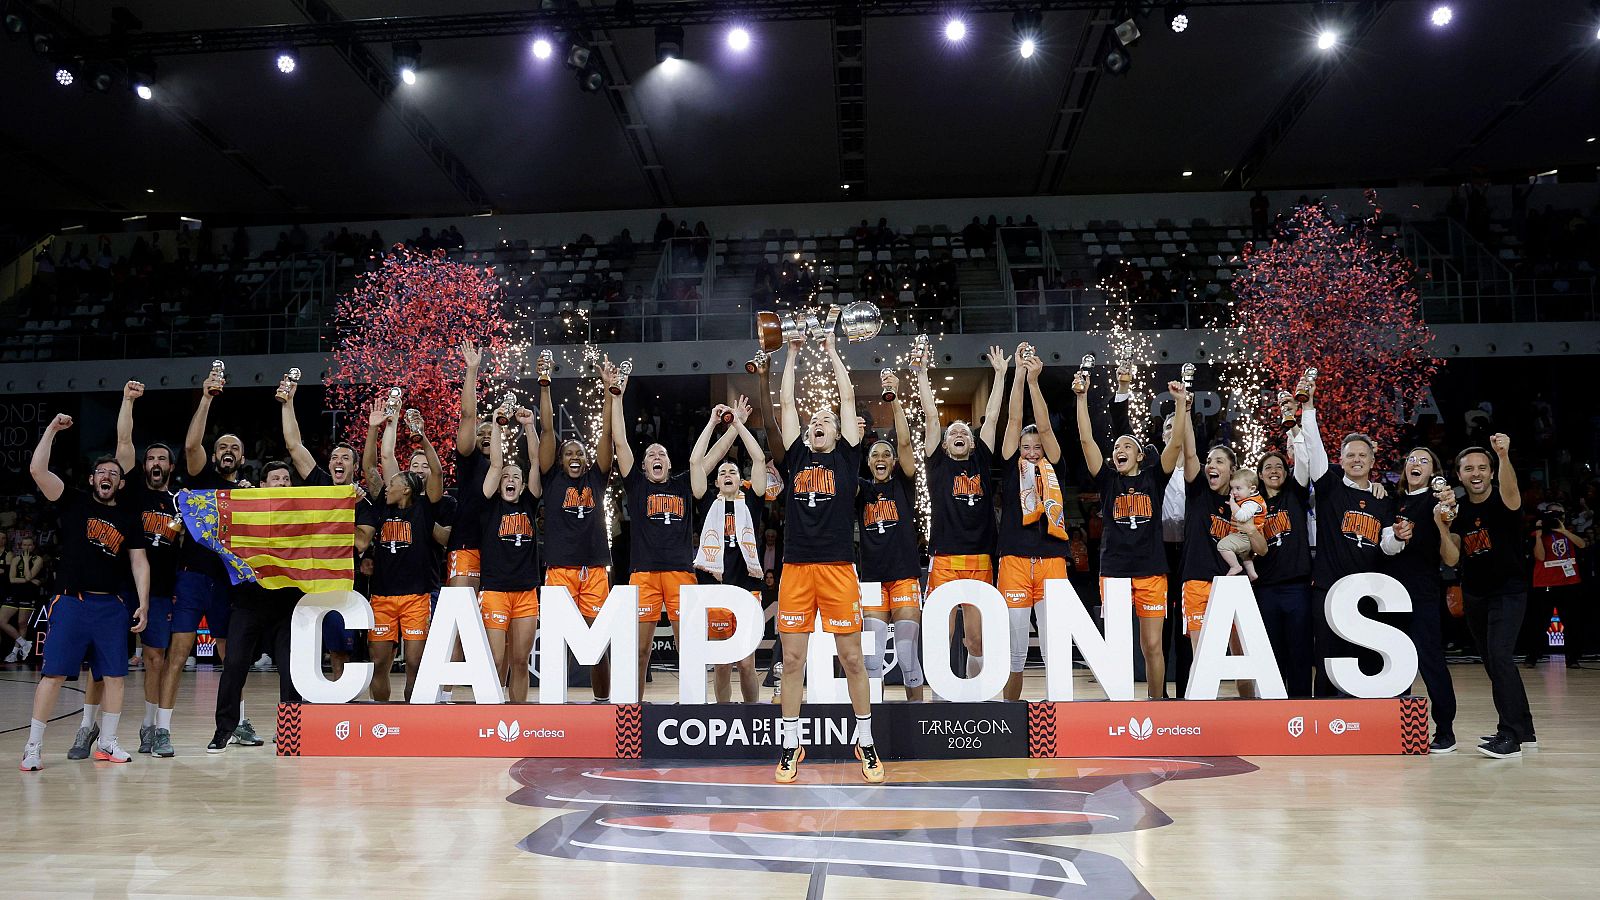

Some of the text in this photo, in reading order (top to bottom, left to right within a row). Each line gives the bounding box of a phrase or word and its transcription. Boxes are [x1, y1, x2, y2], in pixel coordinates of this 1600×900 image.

[752, 718, 771, 731] DE
[918, 719, 1012, 735] TARRAGONA
[1108, 725, 1201, 736] LF endesa
[479, 727, 565, 738] LF endesa
[657, 718, 749, 746] COPA
[752, 733, 772, 745] LA
[948, 736, 982, 749] 2026
